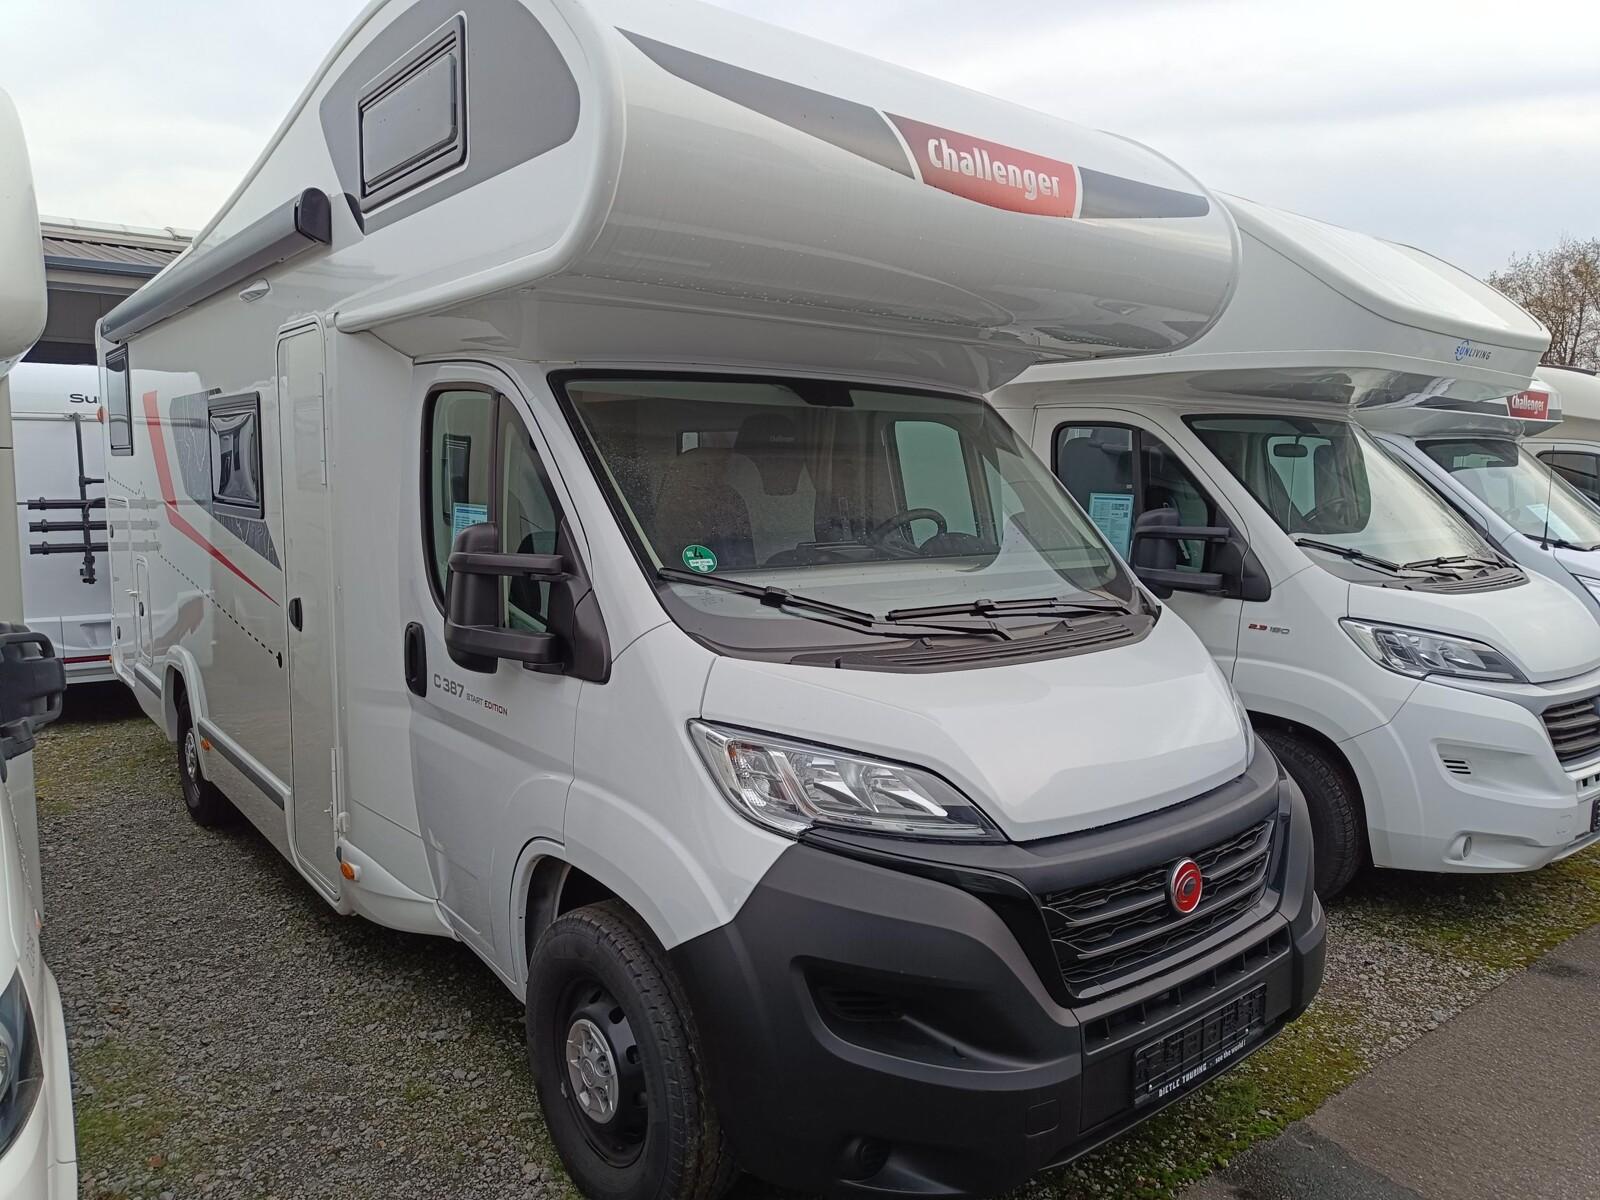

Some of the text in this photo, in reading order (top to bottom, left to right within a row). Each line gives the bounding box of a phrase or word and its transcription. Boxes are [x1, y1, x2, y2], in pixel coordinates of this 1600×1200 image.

[927, 138, 1060, 200] Challenger
[1455, 345, 1492, 360] SUNLIVING
[70, 393, 101, 404] Su
[1511, 393, 1545, 415] Challenger
[433, 673, 508, 716] C 387 START EDITION
[1182, 1062, 1207, 1084] TOURING
